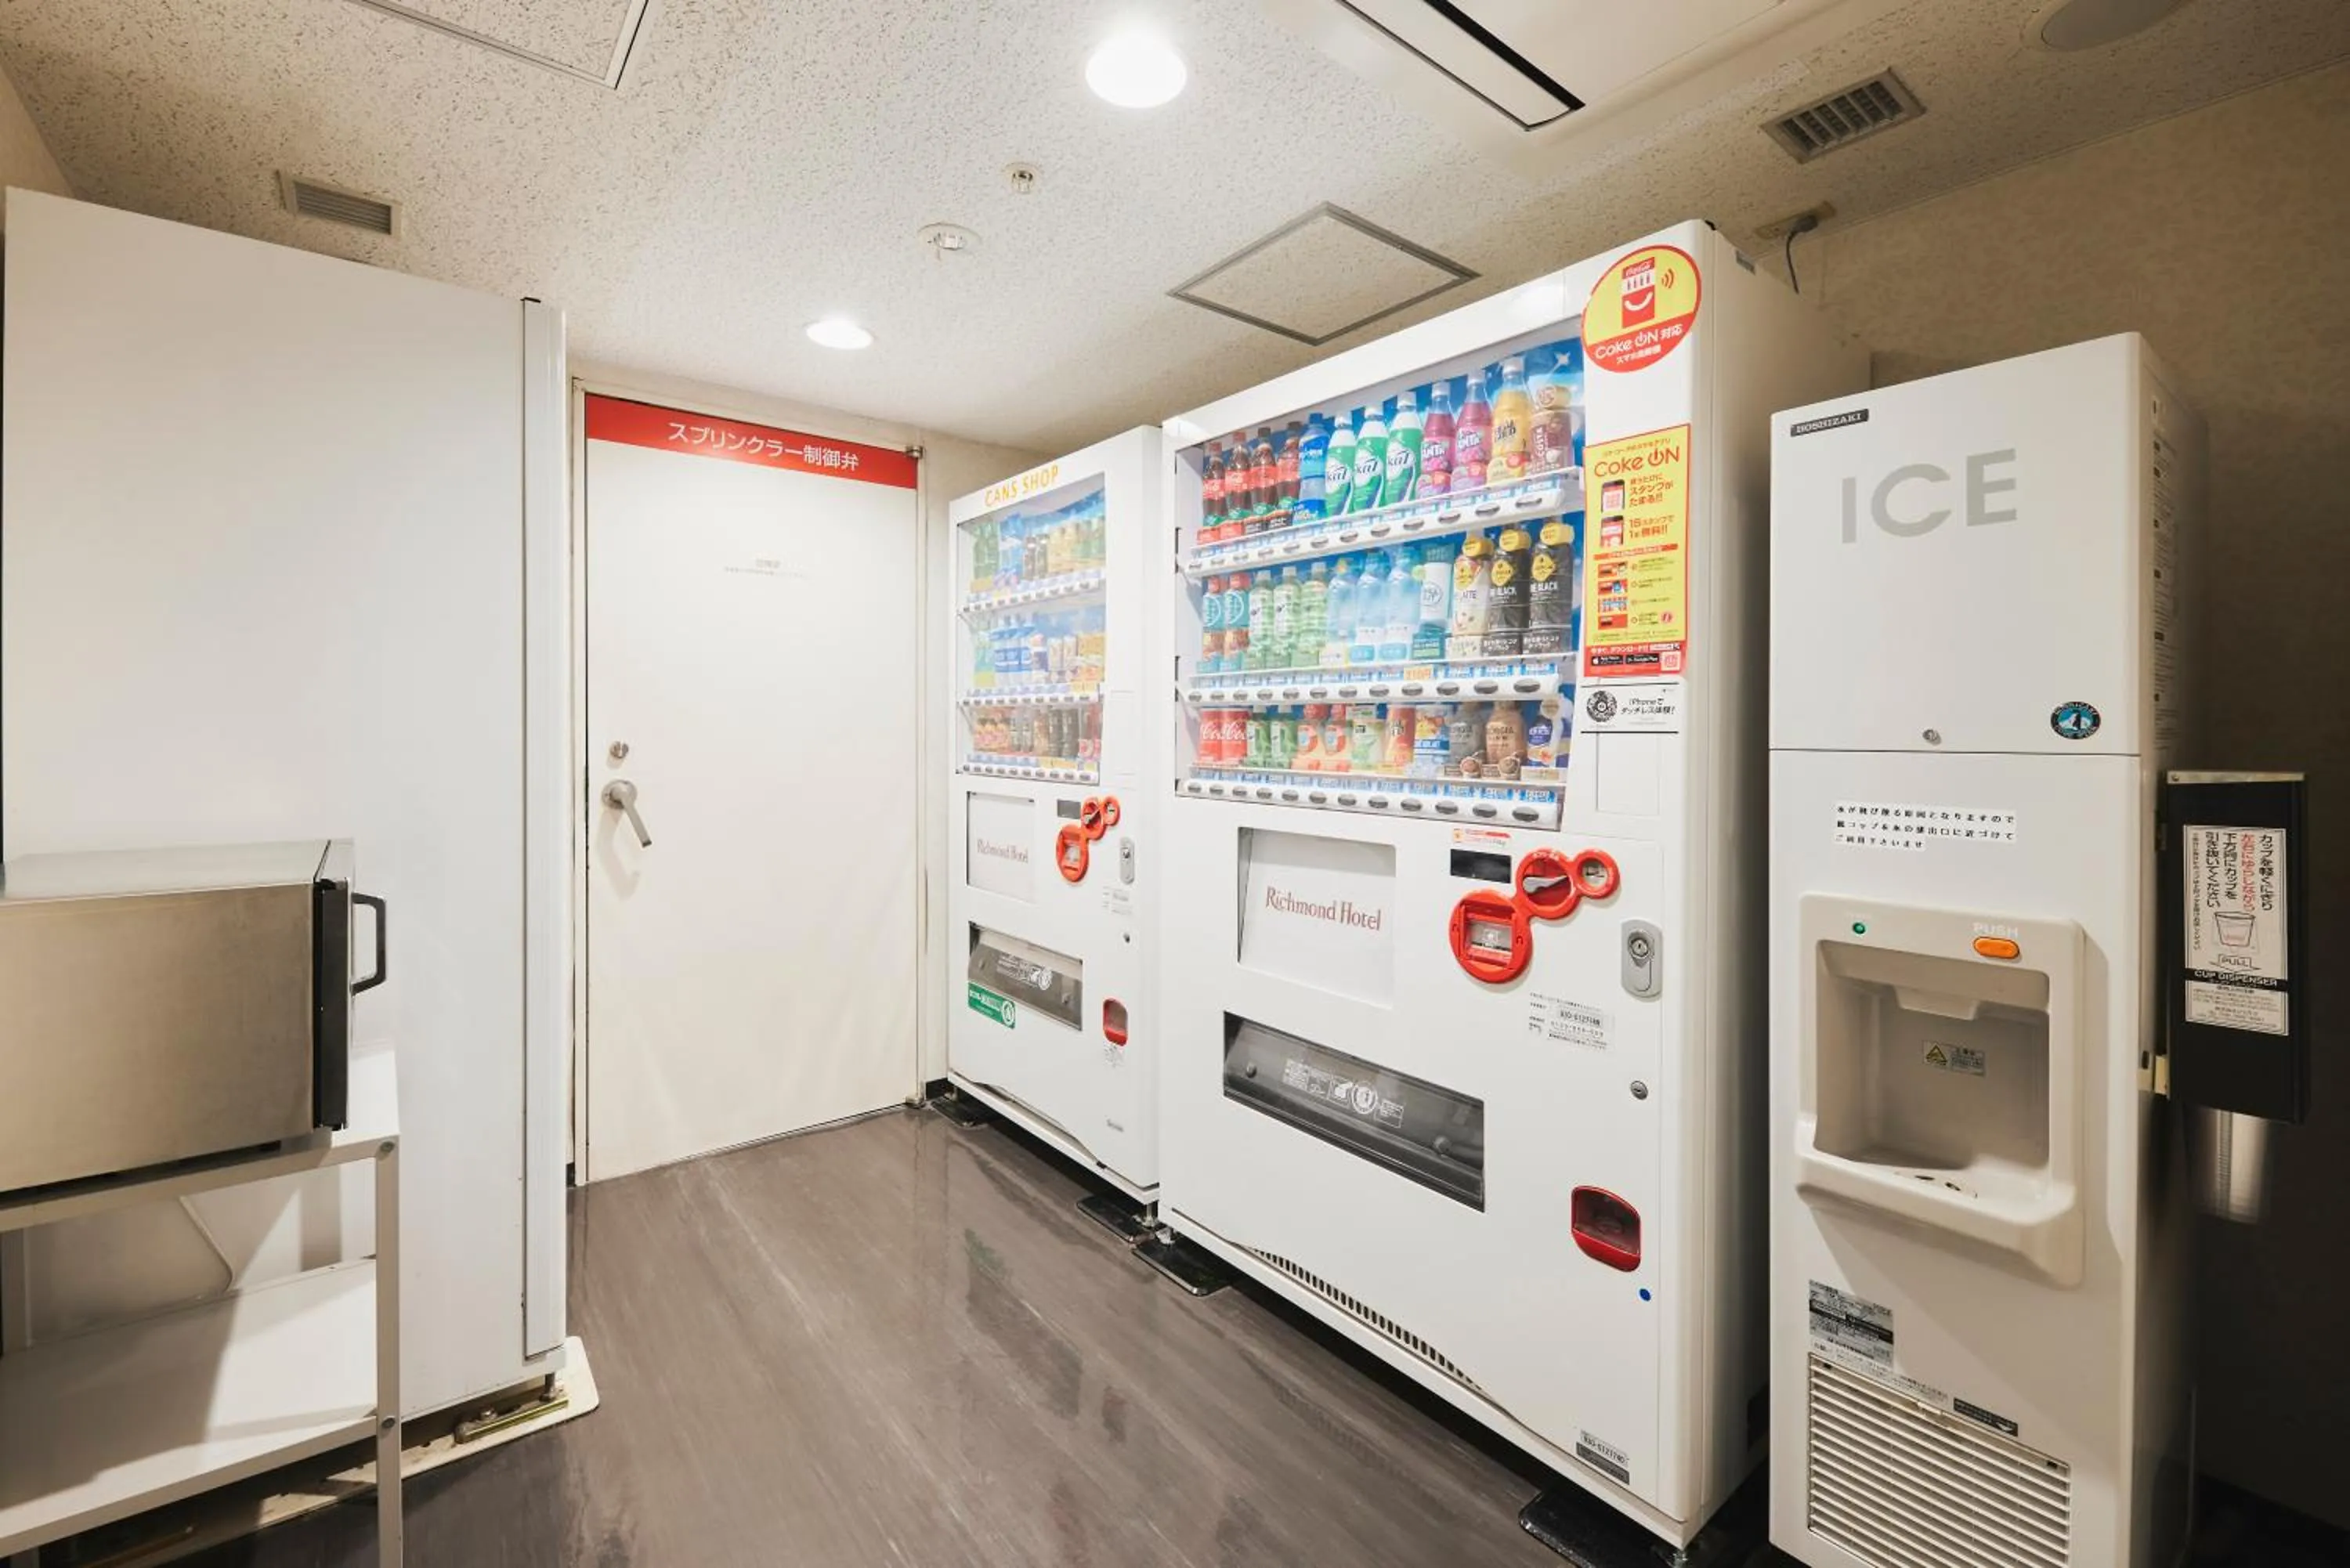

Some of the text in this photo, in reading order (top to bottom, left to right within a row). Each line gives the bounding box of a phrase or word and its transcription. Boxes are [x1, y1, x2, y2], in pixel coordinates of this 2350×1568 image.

[1595, 339, 1632, 360] Coke
[1796, 413, 1862, 433] HOSHIZAKI
[667, 422, 859, 471] スプリンクラー制御弁
[1594, 456, 1644, 477] Coke
[1648, 446, 1680, 467] ON
[985, 465, 1059, 507] CANS SHOP
[1841, 447, 2017, 544] ICE
[1265, 886, 1381, 931] Richmond Hotel
[1973, 922, 2019, 938] PUSH
[2221, 956, 2249, 967] PULL
[2194, 970, 2277, 986] CUP DISPENSER
